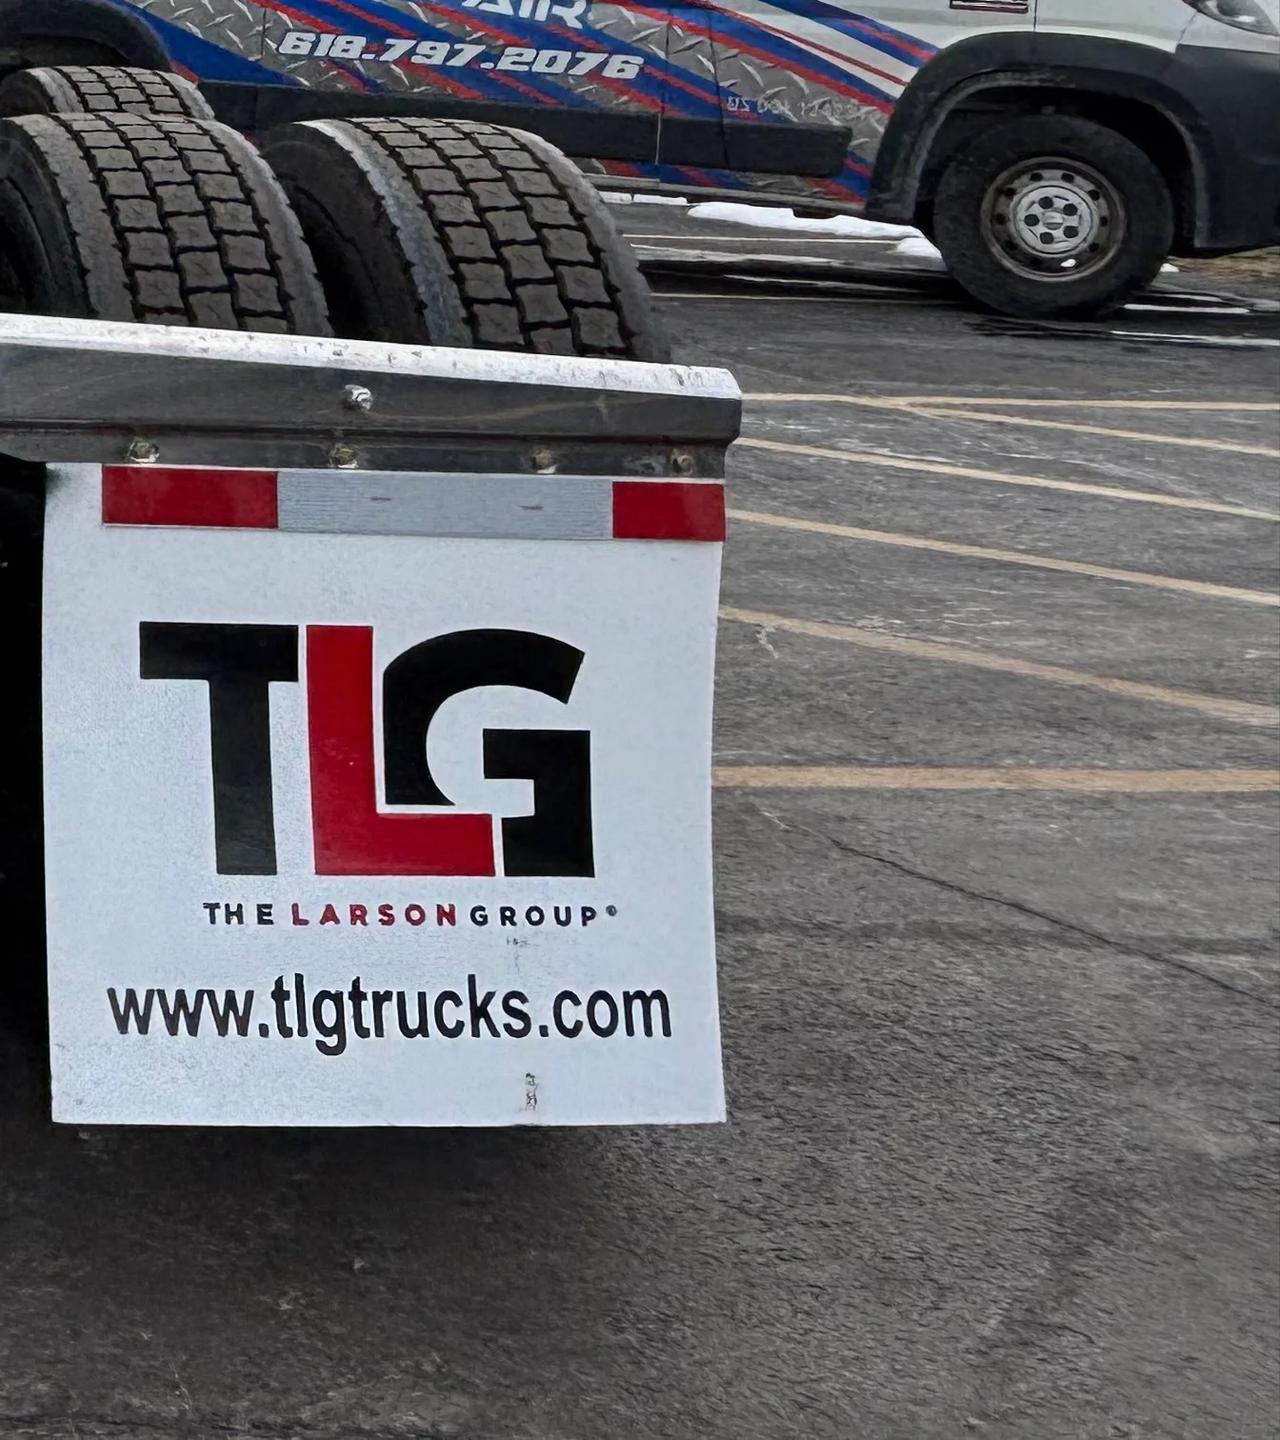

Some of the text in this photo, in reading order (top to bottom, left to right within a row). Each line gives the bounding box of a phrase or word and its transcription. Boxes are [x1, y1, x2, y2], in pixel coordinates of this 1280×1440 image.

[277, 30, 645, 80] 618.797.2076
[139, 620, 596, 878] TLG
[202, 902, 275, 926] THE
[291, 902, 456, 927] LARSON
[106, 972, 672, 1057] www.tlgtrucks.com
